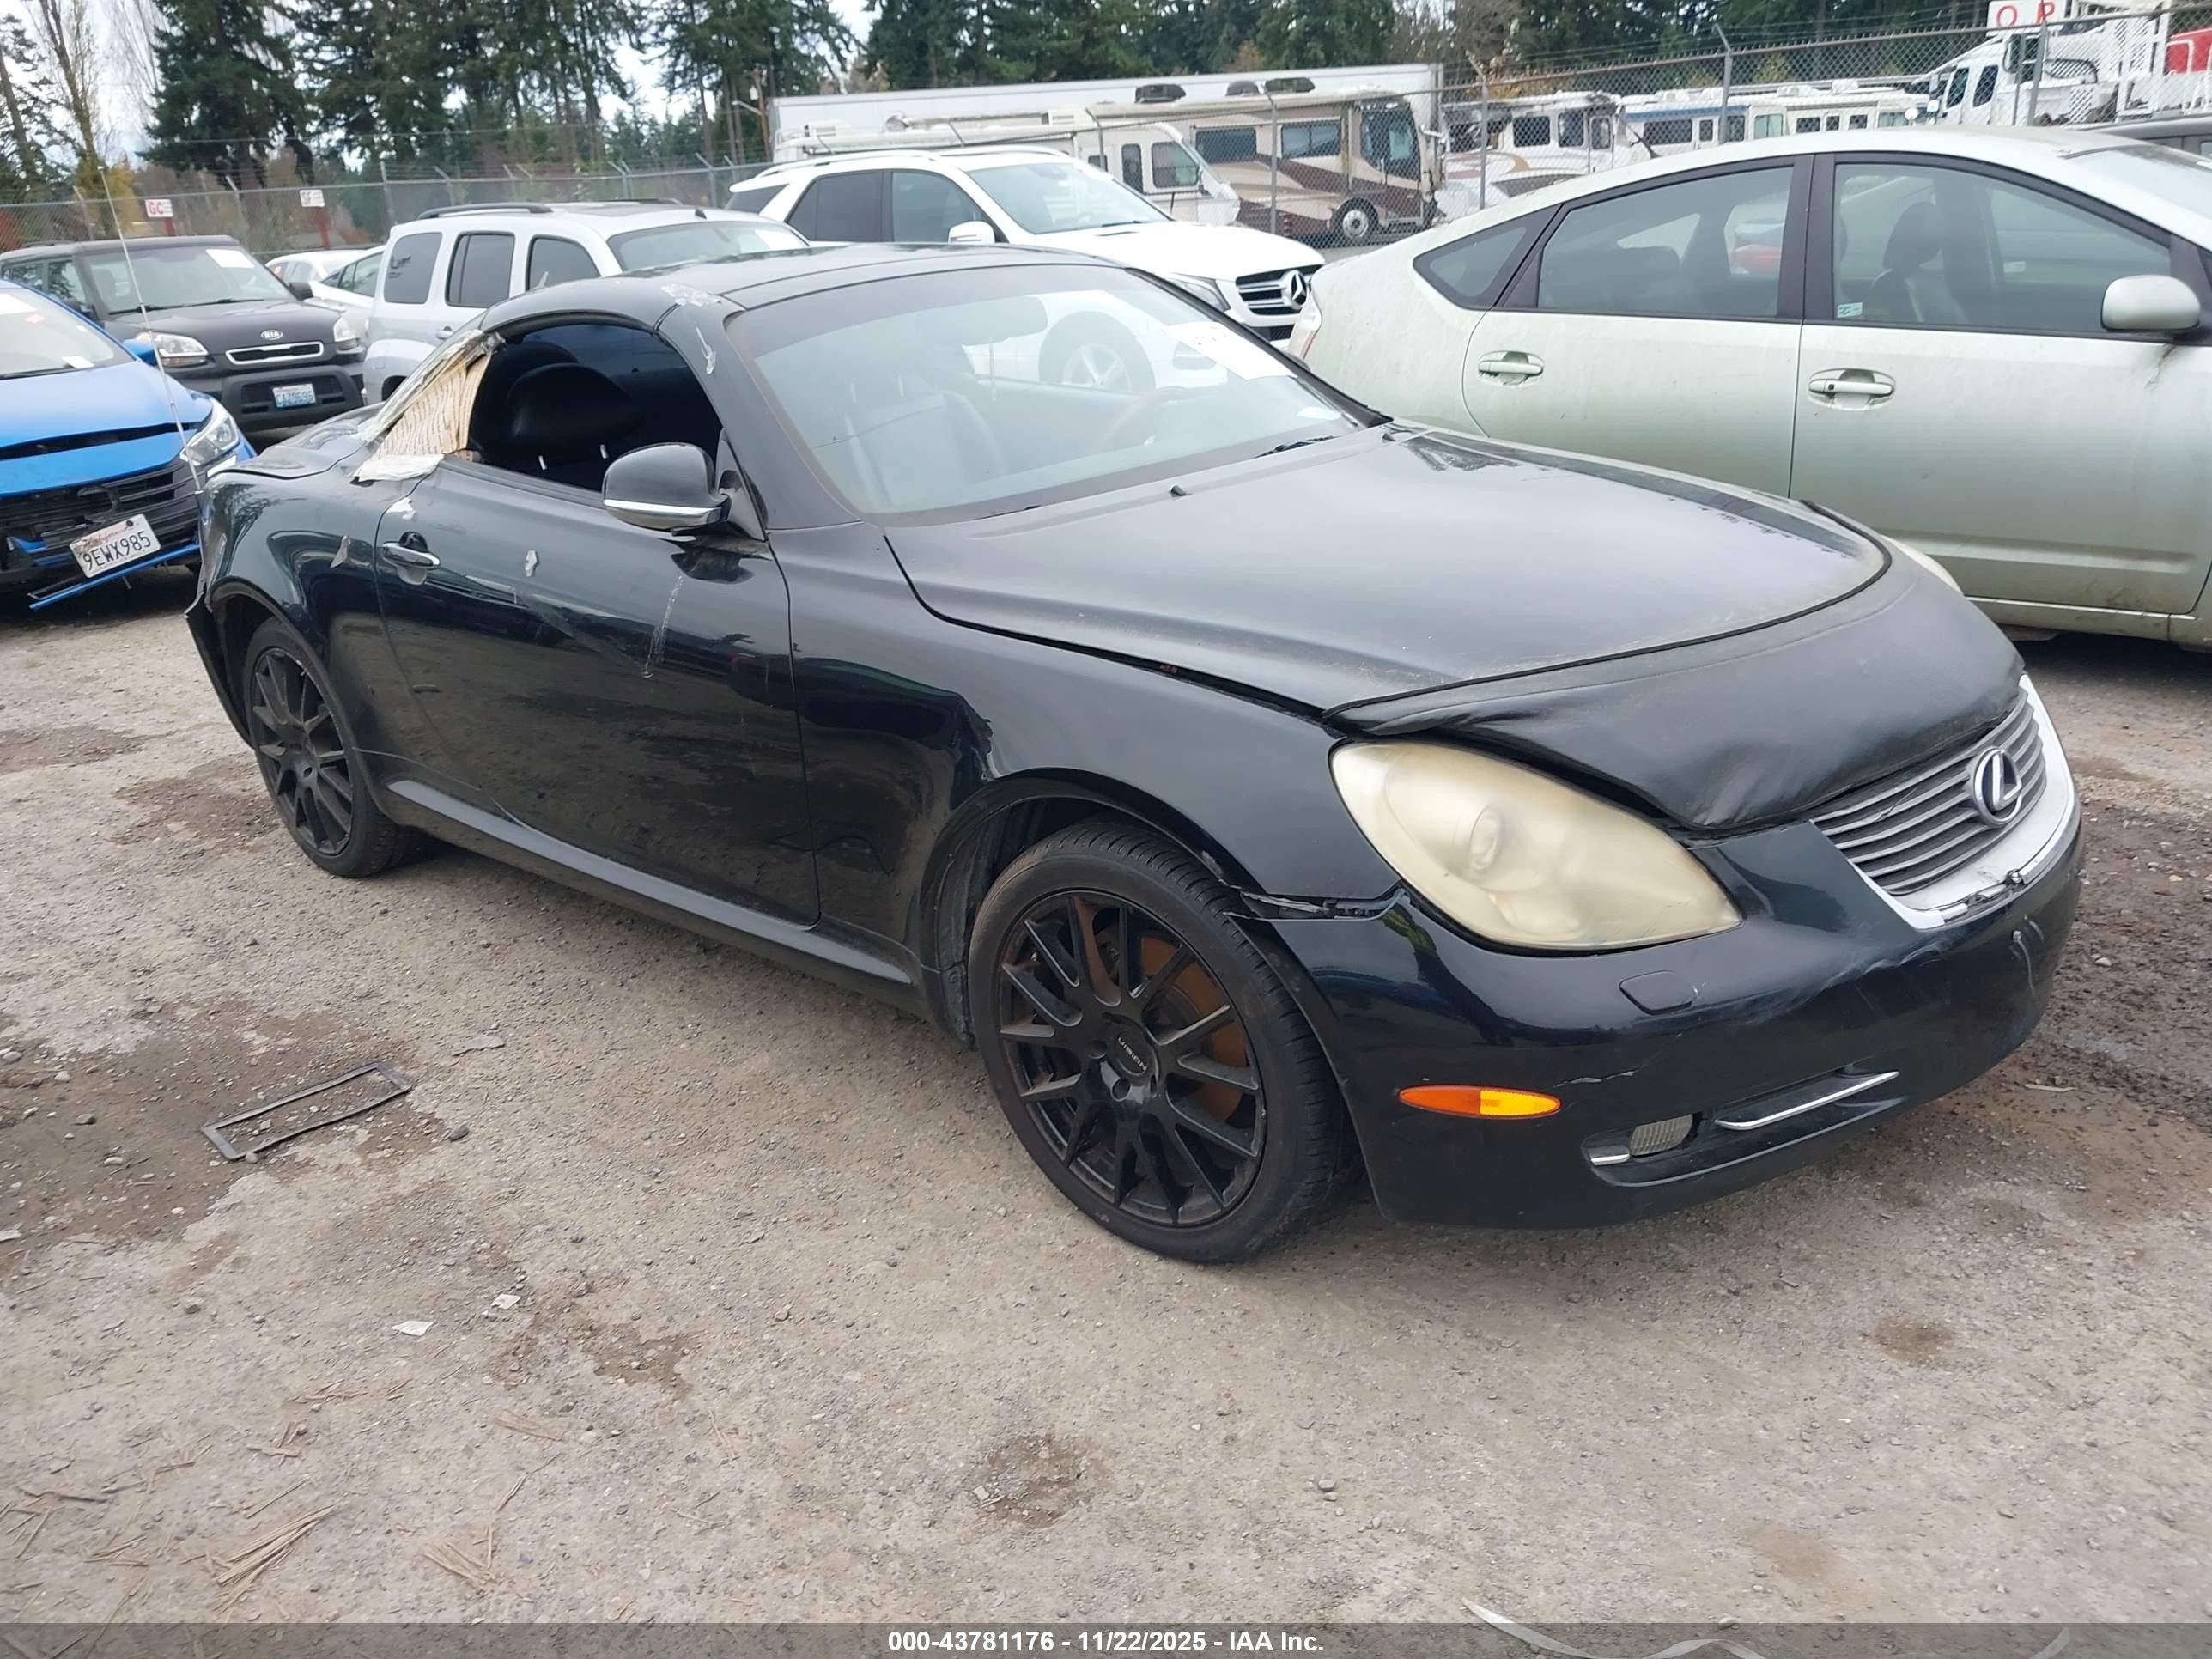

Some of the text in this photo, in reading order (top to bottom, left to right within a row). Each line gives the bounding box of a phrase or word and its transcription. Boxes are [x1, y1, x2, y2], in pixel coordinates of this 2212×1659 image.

[149, 202, 164, 215] GC
[82, 531, 151, 570] 9EWX985
[1118, 1037, 1147, 1071] VISION
